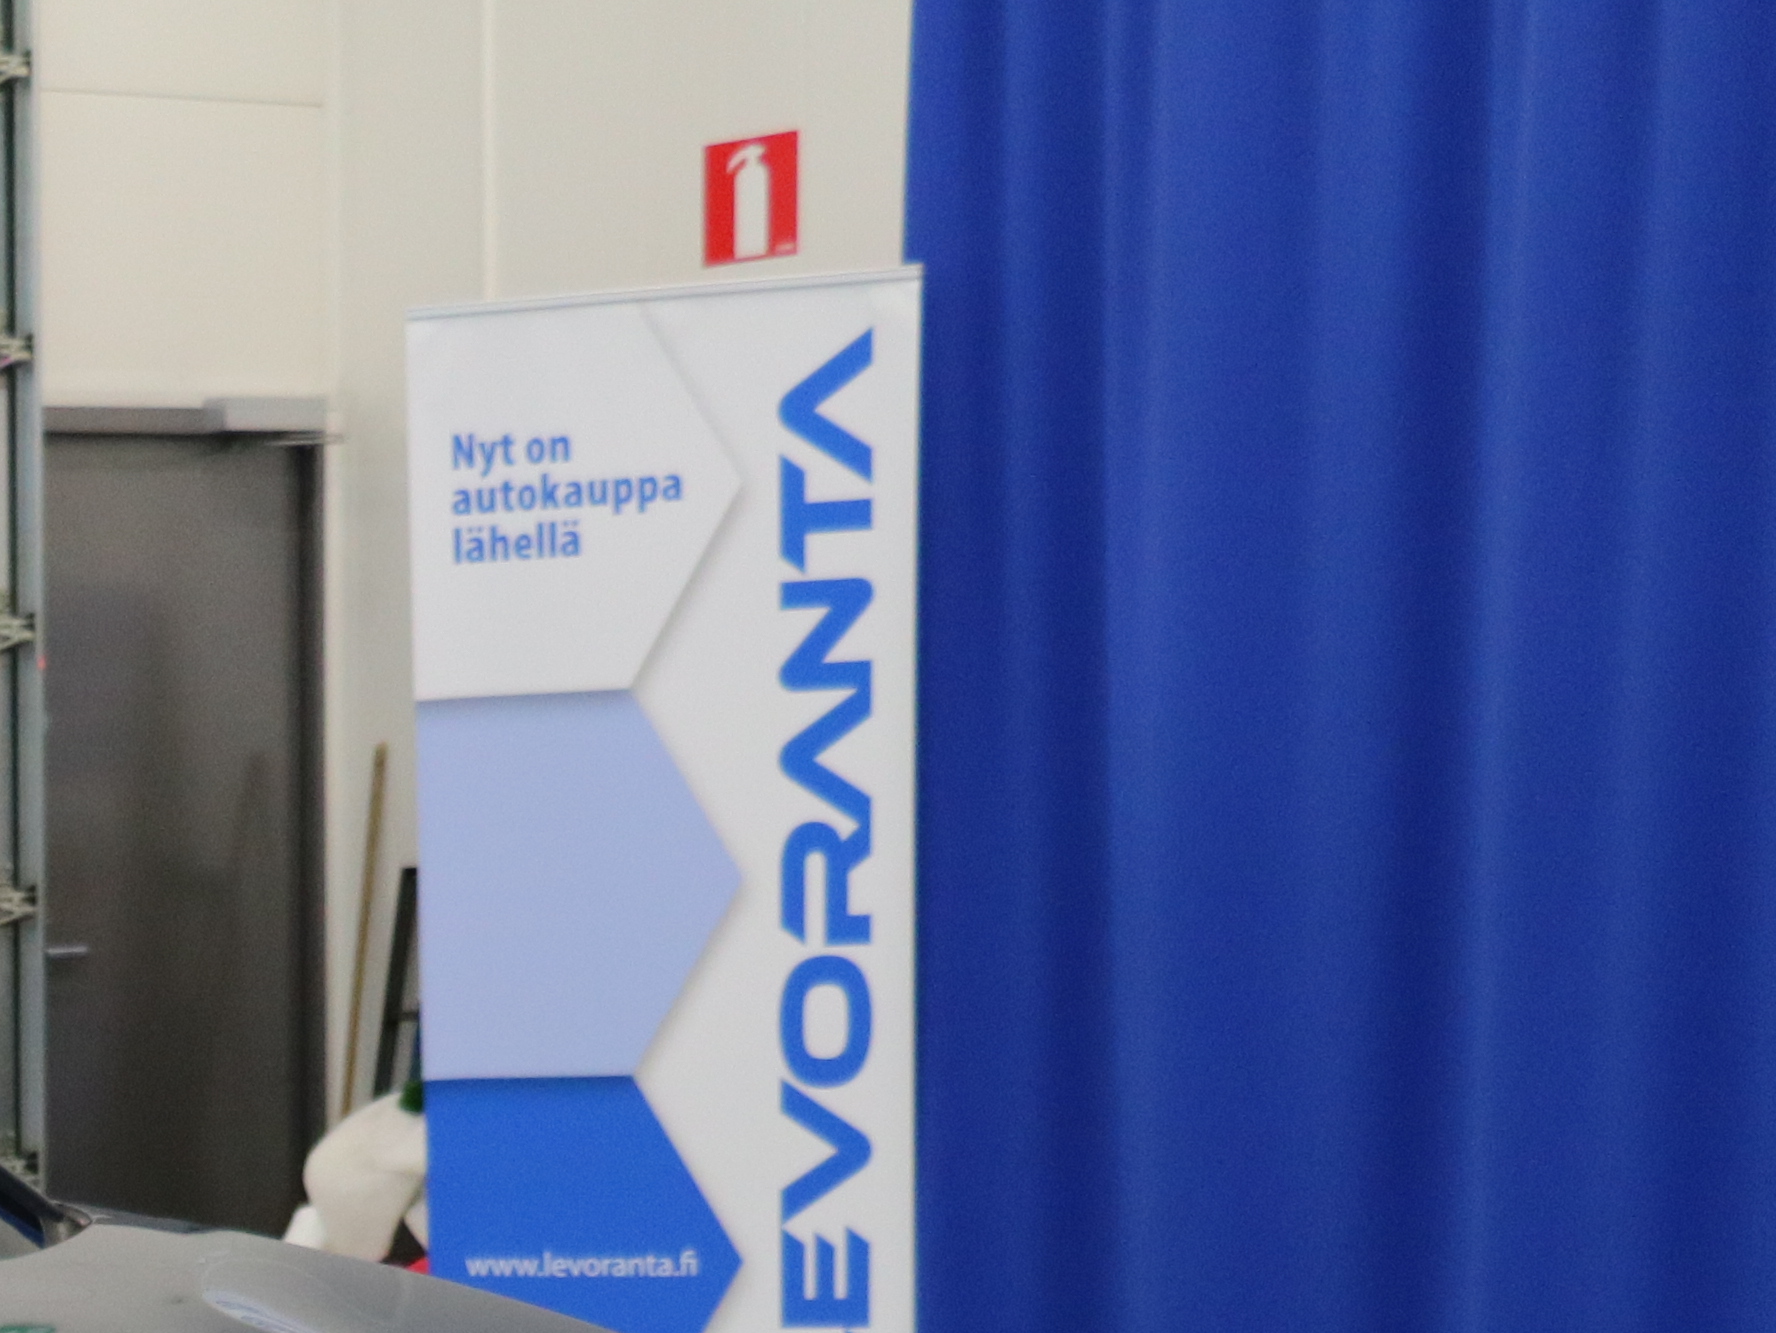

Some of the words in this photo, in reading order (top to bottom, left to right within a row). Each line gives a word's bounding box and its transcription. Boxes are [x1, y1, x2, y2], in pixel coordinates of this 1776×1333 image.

[451, 432, 514, 477] Nyt
[527, 431, 572, 464] on
[451, 472, 683, 516] autokauppa
[453, 520, 582, 565] lähellä
[465, 1248, 698, 1280] www.levoranta.fi
